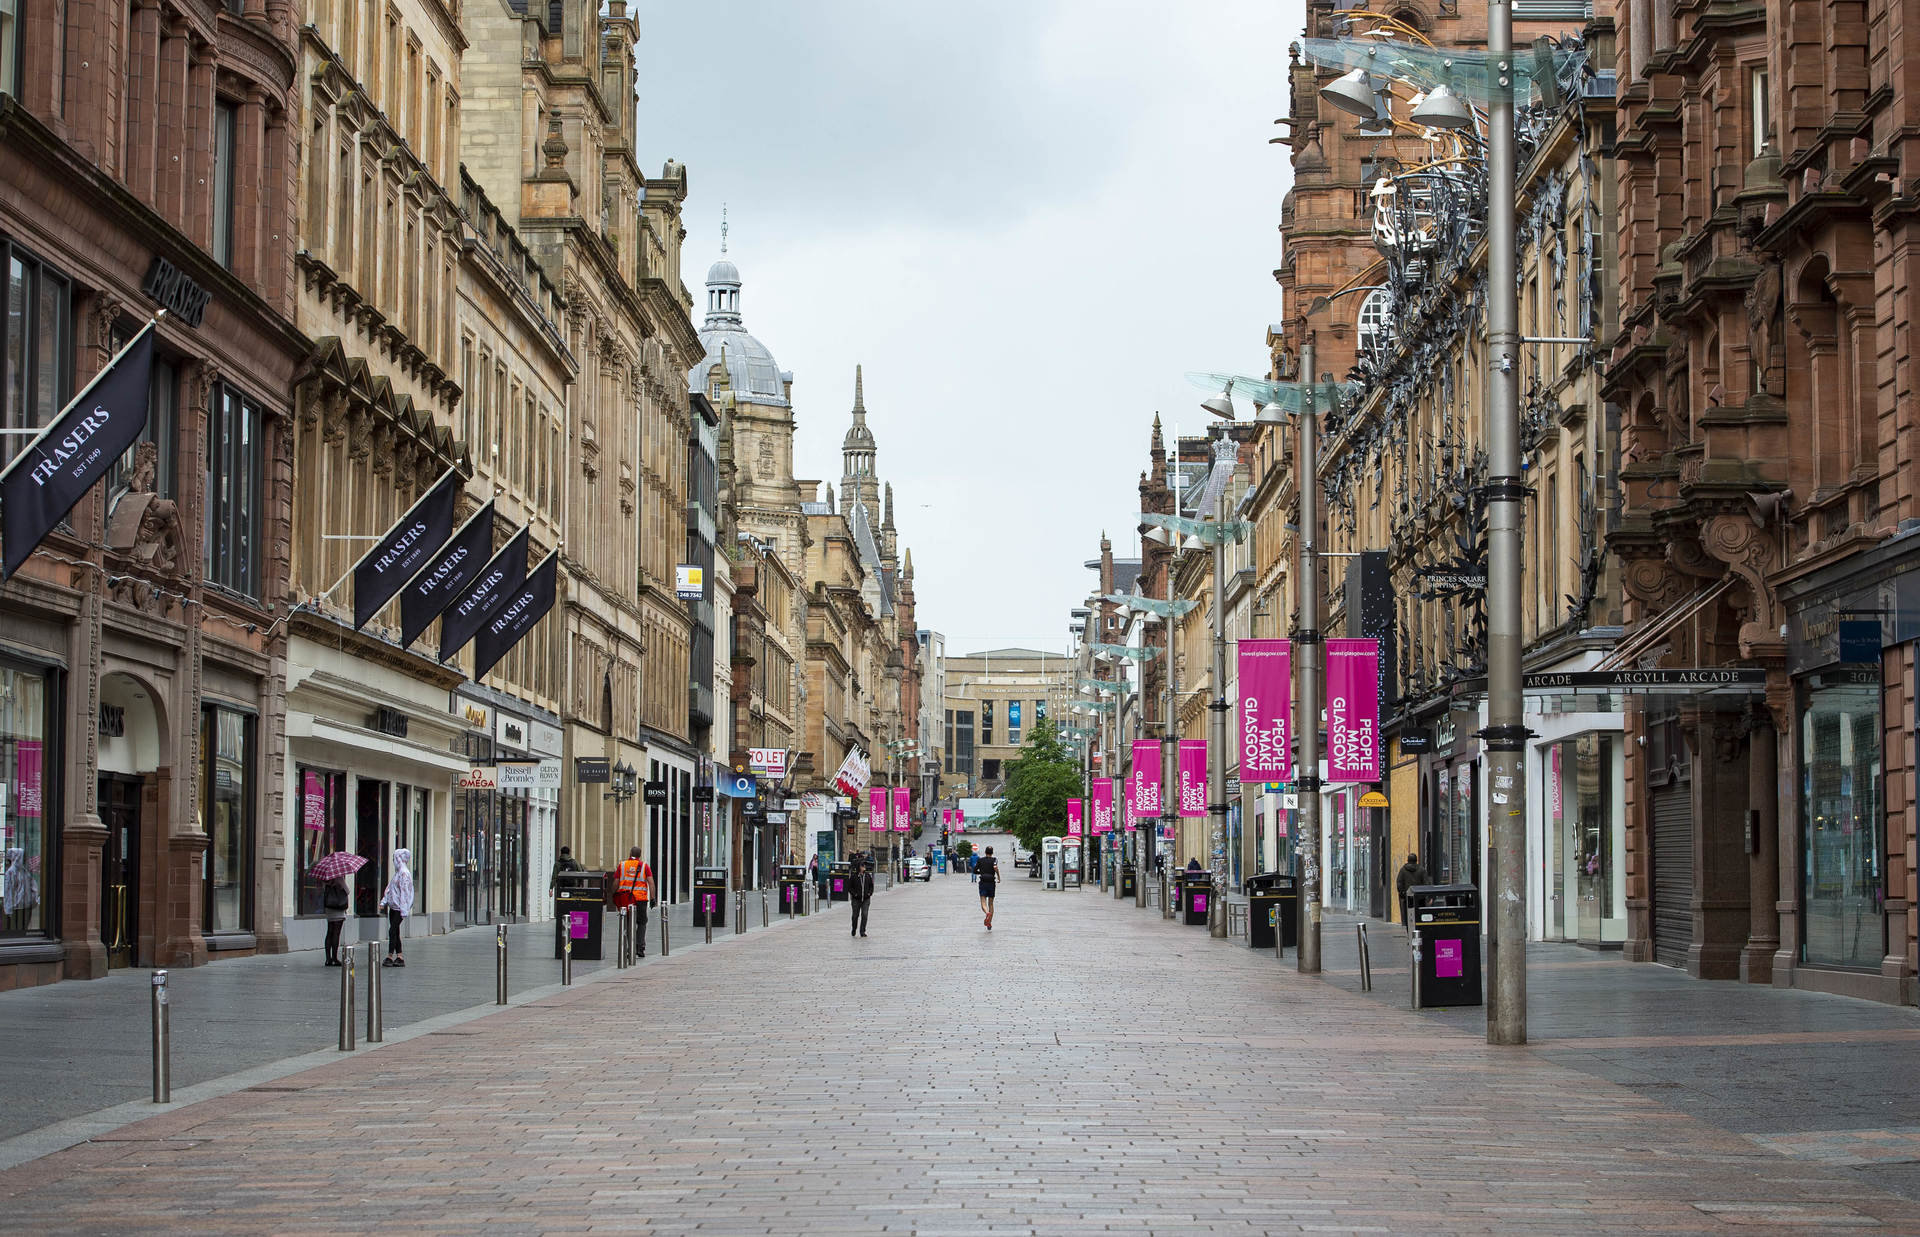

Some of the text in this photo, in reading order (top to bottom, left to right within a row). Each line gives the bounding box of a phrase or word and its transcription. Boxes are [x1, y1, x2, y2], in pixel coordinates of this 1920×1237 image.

[150, 256, 213, 329] FRASERS
[30, 405, 110, 487] FRASERS
[72, 448, 101, 478] EST 1849
[374, 520, 427, 574] FRASERS
[402, 548, 422, 569] EST 1849
[419, 545, 468, 596] FRASERS
[445, 571, 464, 591] EST 1849
[1427, 575, 1487, 584] PRINCES SQUARE
[457, 569, 504, 616] FRASERS
[481, 593, 499, 612] EST 1849
[491, 591, 534, 635] FRASERS
[1527, 674, 1572, 686] ARCADE
[1614, 672, 1739, 684] ARGYLL ARCADE
[1245, 697, 1258, 771] GLASGOW
[1259, 730, 1271, 771] MAKE
[1272, 719, 1285, 771] PEOPLE
[1333, 697, 1346, 771] GLASGOW
[1346, 730, 1359, 771] MAKE
[1359, 719, 1372, 771] PEOPLE
[505, 766, 532, 775] Russell
[749, 751, 784, 763] TO LET
[460, 779, 495, 788] OMEGA
[505, 774, 536, 784] Bromley
[1136, 770, 1144, 812] GLASGOW
[1150, 782, 1158, 811] PEOPLE
[1182, 770, 1190, 812] GLASGOW
[1197, 782, 1205, 811] PEOPLE
